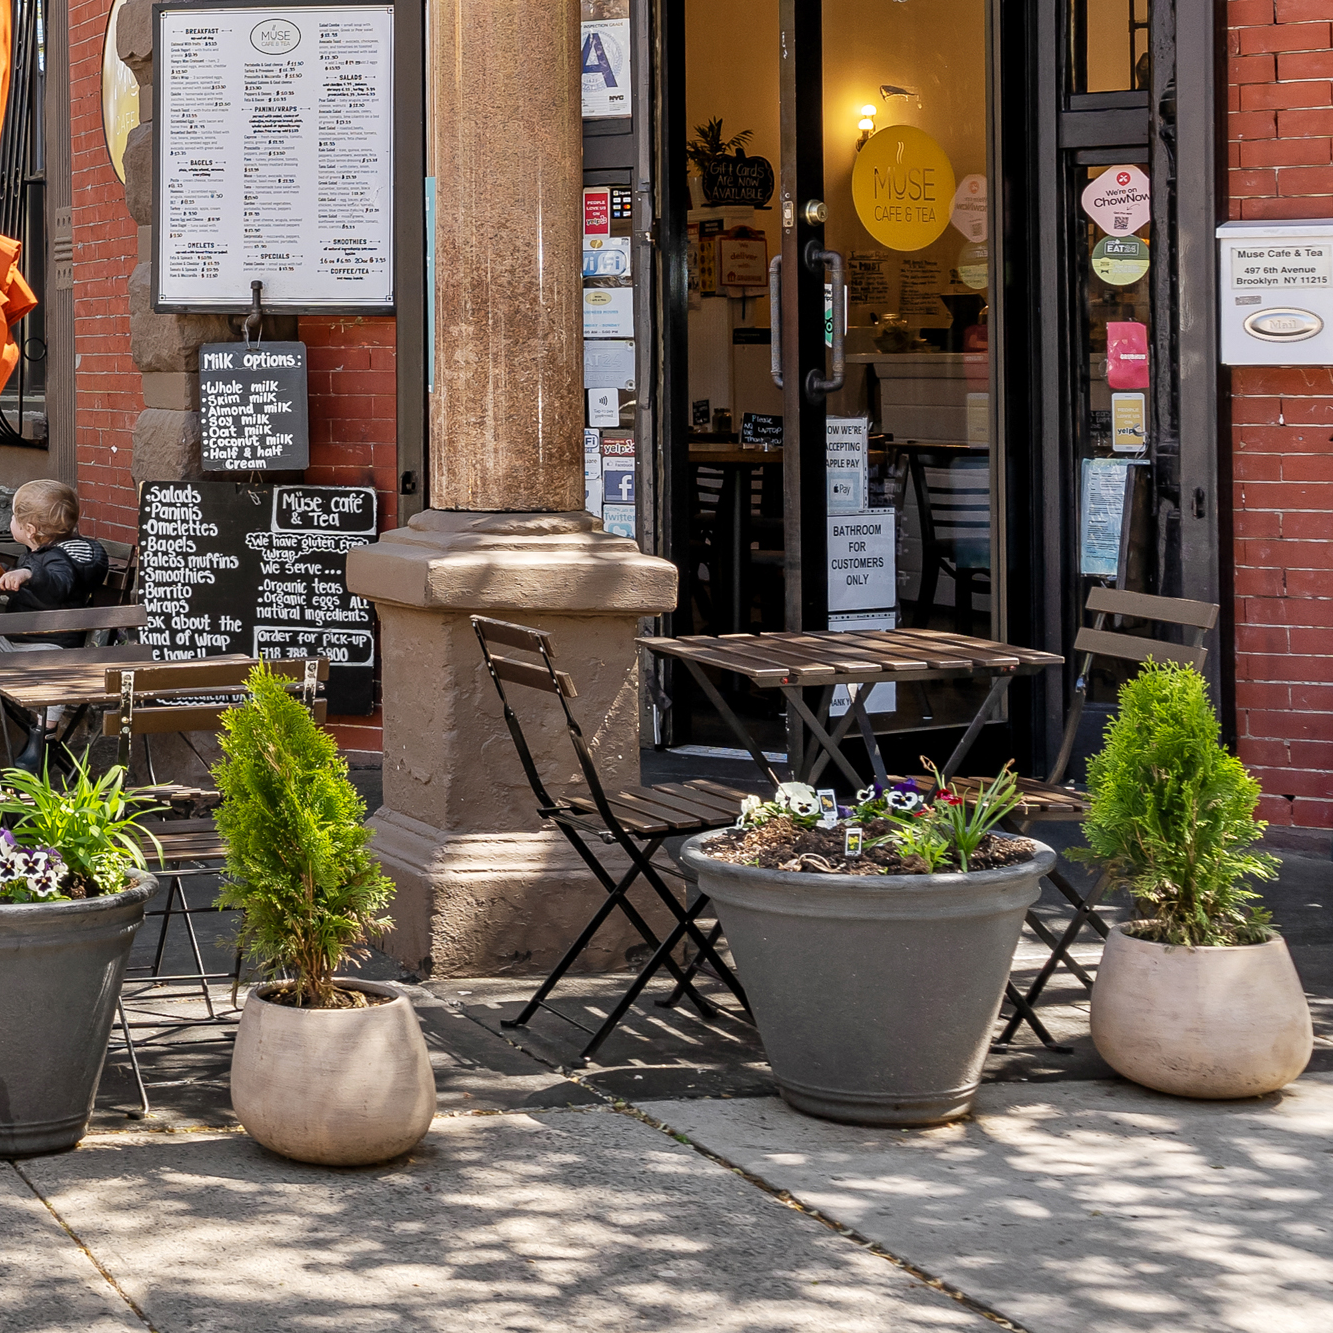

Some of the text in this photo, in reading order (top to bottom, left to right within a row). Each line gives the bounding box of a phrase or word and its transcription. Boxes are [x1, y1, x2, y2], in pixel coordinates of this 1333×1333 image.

[261, 31, 291, 41] MUSE
[582, 33, 618, 87] A
[710, 162, 765, 178] Gift Cards
[717, 175, 734, 187] Are
[874, 166, 936, 201] MUSE
[712, 188, 764, 200] AVAILABLE
[1094, 192, 1150, 208] ChowNow
[1105, 189, 1126, 197] We're
[874, 206, 936, 222] CAFE & TEA
[586, 218, 601, 226] yelp
[730, 252, 758, 260] deliver
[1107, 245, 1137, 253] EAT24
[1238, 249, 1323, 258] Muse Cafe & Tea
[1281, 266, 1316, 274] Avenue
[1236, 277, 1278, 286] Brooklyn
[1300, 276, 1328, 284] 11215
[1269, 320, 1297, 329] Mail
[206, 380, 243, 394] Whole
[207, 404, 254, 417] Almond
[209, 426, 237, 438] Oat
[841, 425, 862, 435] WE'RE
[1117, 427, 1134, 435] yelp
[210, 445, 283, 459] Half & half
[604, 445, 626, 455] yelp
[825, 458, 860, 468] APPLE PAY
[151, 484, 201, 504] Salads
[840, 484, 851, 496] Pay
[282, 491, 365, 514] Müse café
[151, 503, 202, 521] Paninis
[290, 511, 340, 527] & Tea
[147, 519, 218, 536] Omelettes
[833, 524, 882, 537] BATHROOM
[148, 536, 196, 556] Bagels
[251, 534, 335, 552] We have gluten
[848, 541, 866, 553] FOR
[187, 553, 239, 569] muffins
[260, 561, 280, 574] We
[831, 557, 884, 569] CUSTOMERS
[145, 568, 215, 584] Smoothies
[846, 574, 869, 586] ONLY
[145, 583, 192, 598] Burrito
[264, 578, 343, 595] Organic teas
[145, 599, 189, 616] Wraps
[264, 592, 306, 609] Organic
[312, 596, 340, 611] eggs
[256, 606, 369, 626] natural ingredients
[172, 615, 242, 632] about the
[176, 629, 192, 645] of
[258, 630, 293, 642] Order
[297, 632, 318, 644] for
[317, 647, 348, 662] 5800
